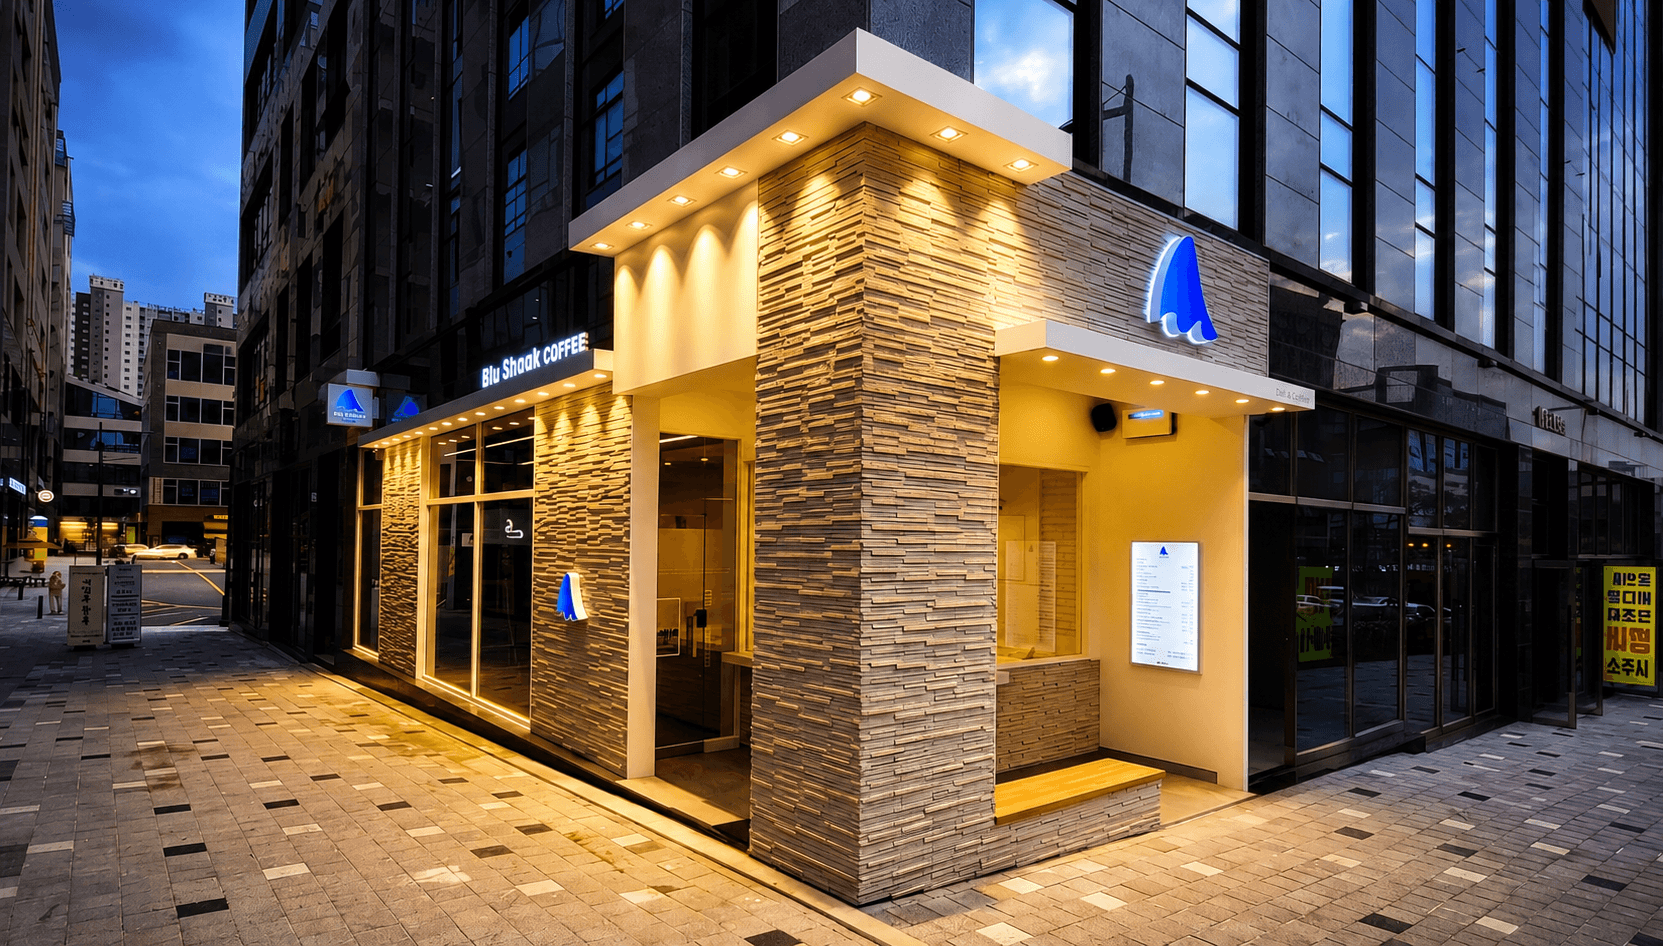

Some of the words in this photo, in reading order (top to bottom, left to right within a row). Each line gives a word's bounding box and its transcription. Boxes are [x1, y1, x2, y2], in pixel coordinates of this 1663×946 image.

[482, 365, 500, 388] Blu
[502, 347, 541, 380] Shaak
[543, 332, 588, 364] COFFEE
